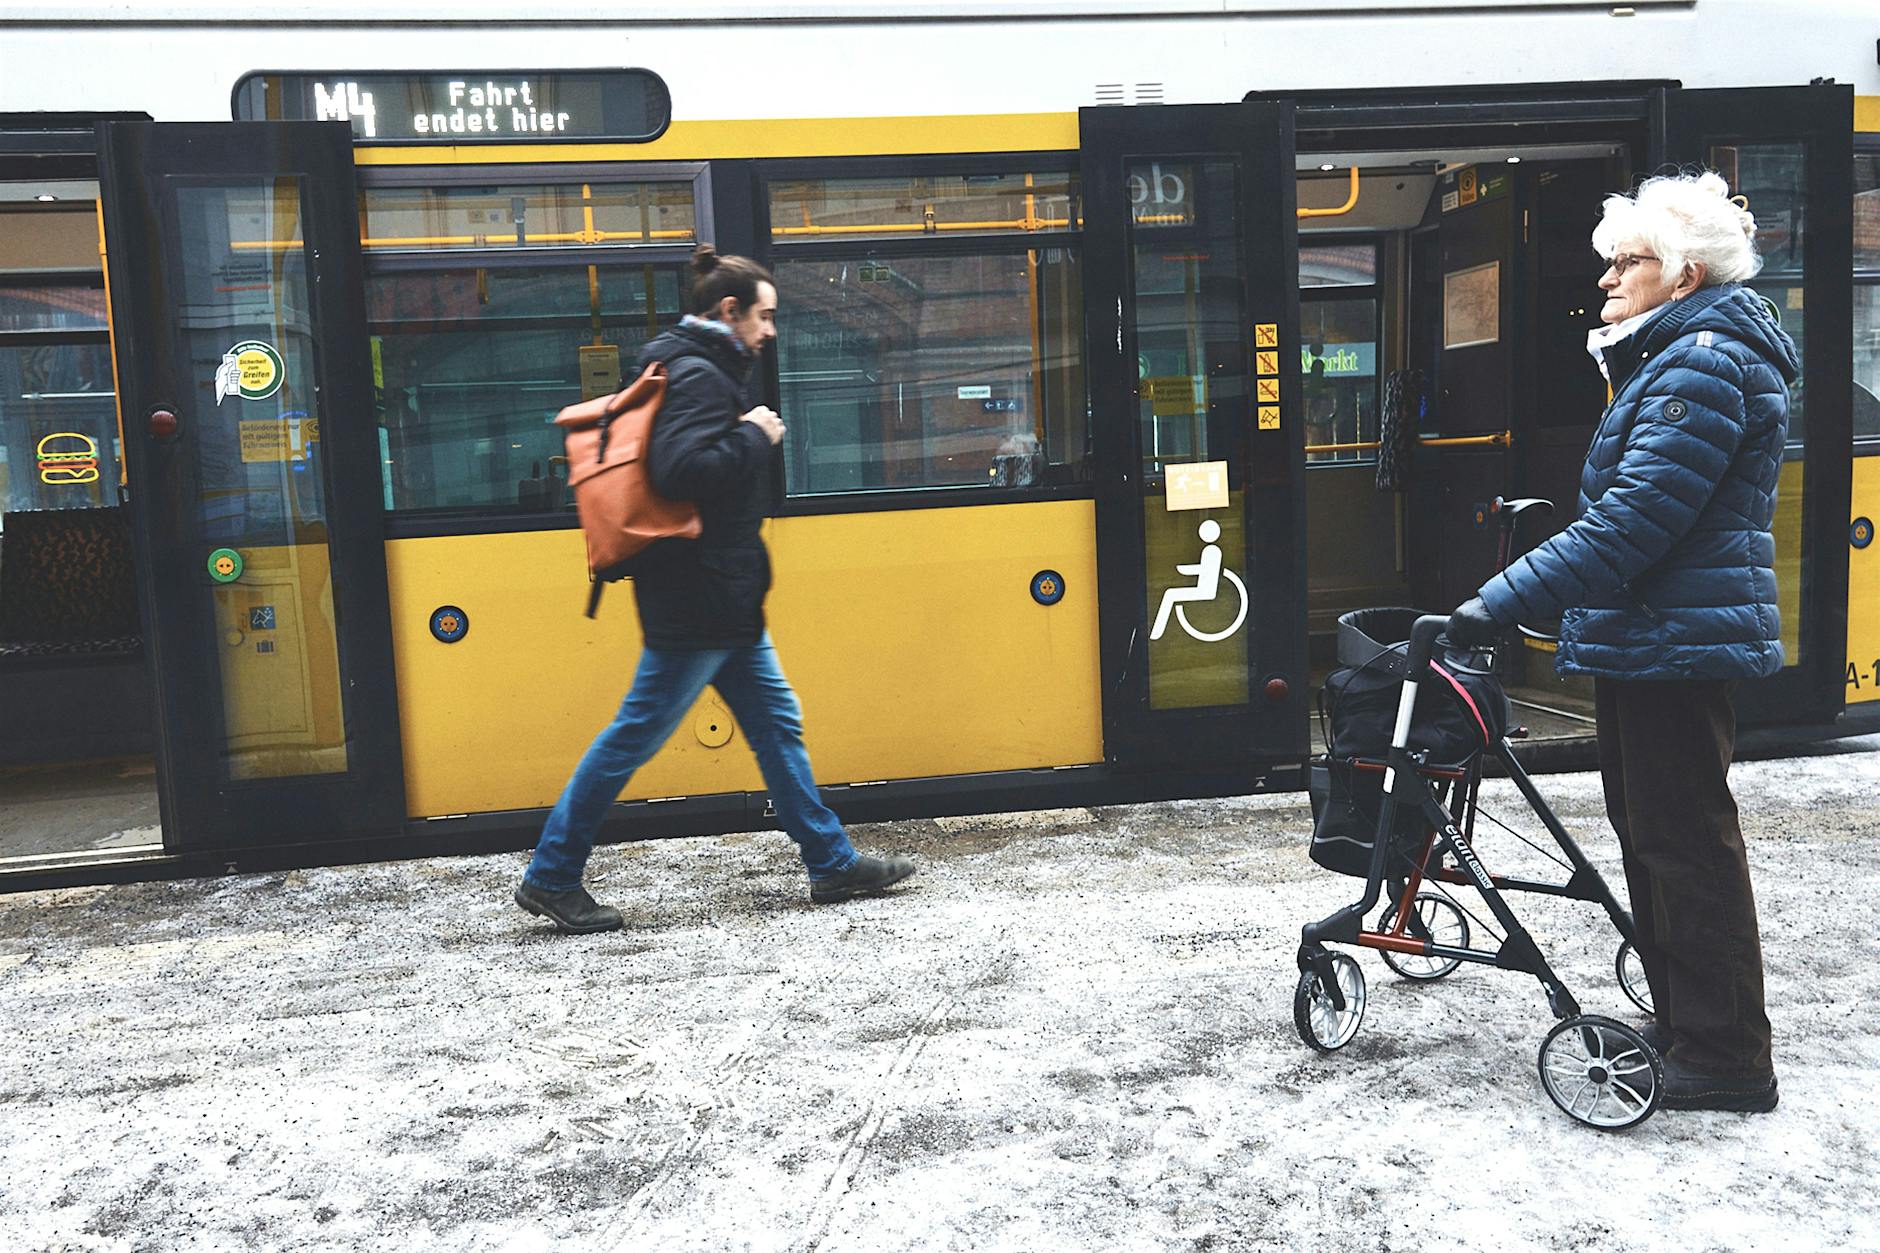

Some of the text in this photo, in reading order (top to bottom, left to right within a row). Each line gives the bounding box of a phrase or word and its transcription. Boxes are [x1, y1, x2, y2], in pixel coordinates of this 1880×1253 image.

[449, 81, 533, 106] Fahrt
[314, 82, 376, 137] M4
[413, 107, 570, 132] endet hier
[1301, 348, 1358, 374] Mrkt
[1445, 824, 1491, 889] elan classic
